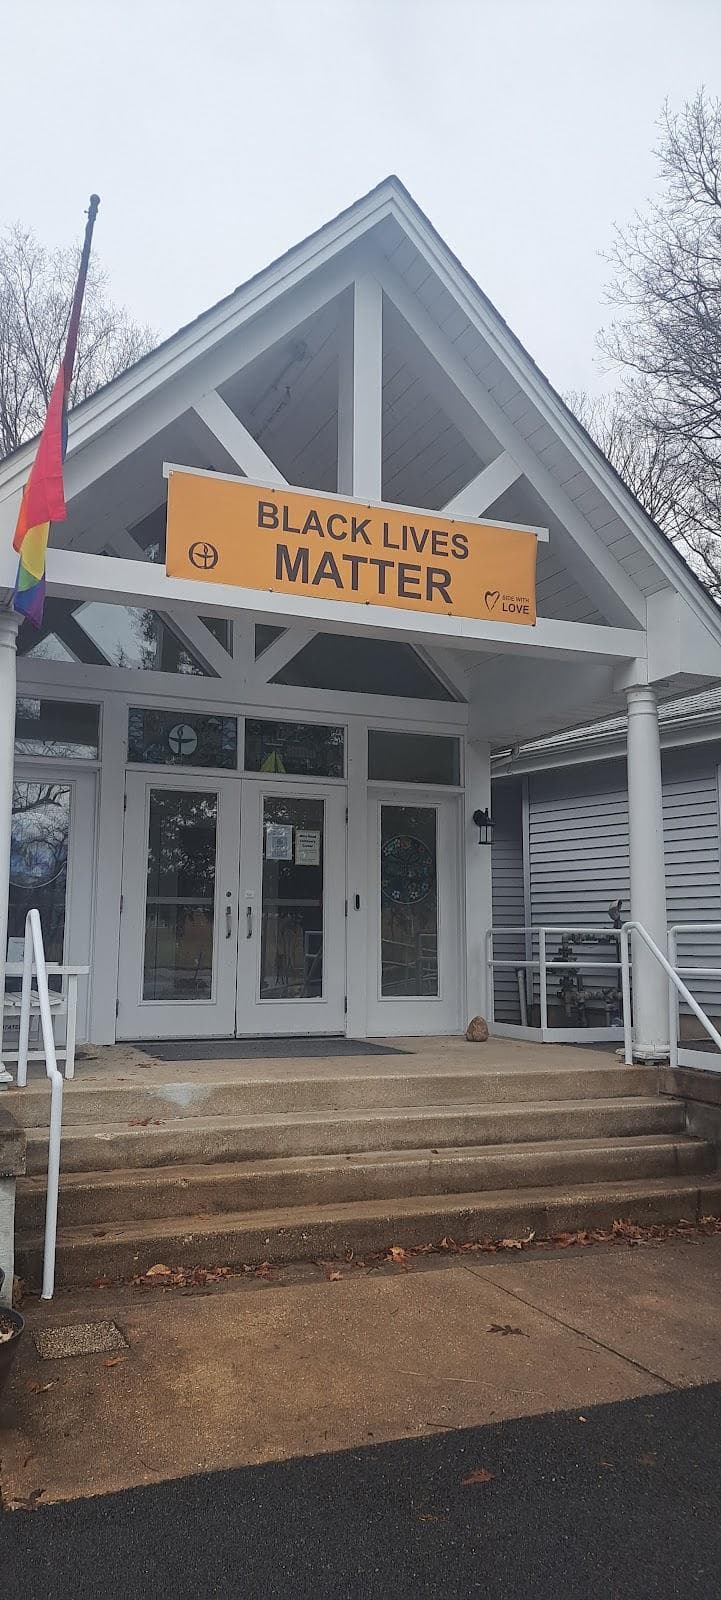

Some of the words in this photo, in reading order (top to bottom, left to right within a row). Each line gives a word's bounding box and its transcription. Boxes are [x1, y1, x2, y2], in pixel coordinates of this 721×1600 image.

[257, 500, 372, 545] BLACK
[383, 522, 469, 560] LIVES
[275, 543, 453, 604] MATTER
[502, 602, 529, 614] LOVE
